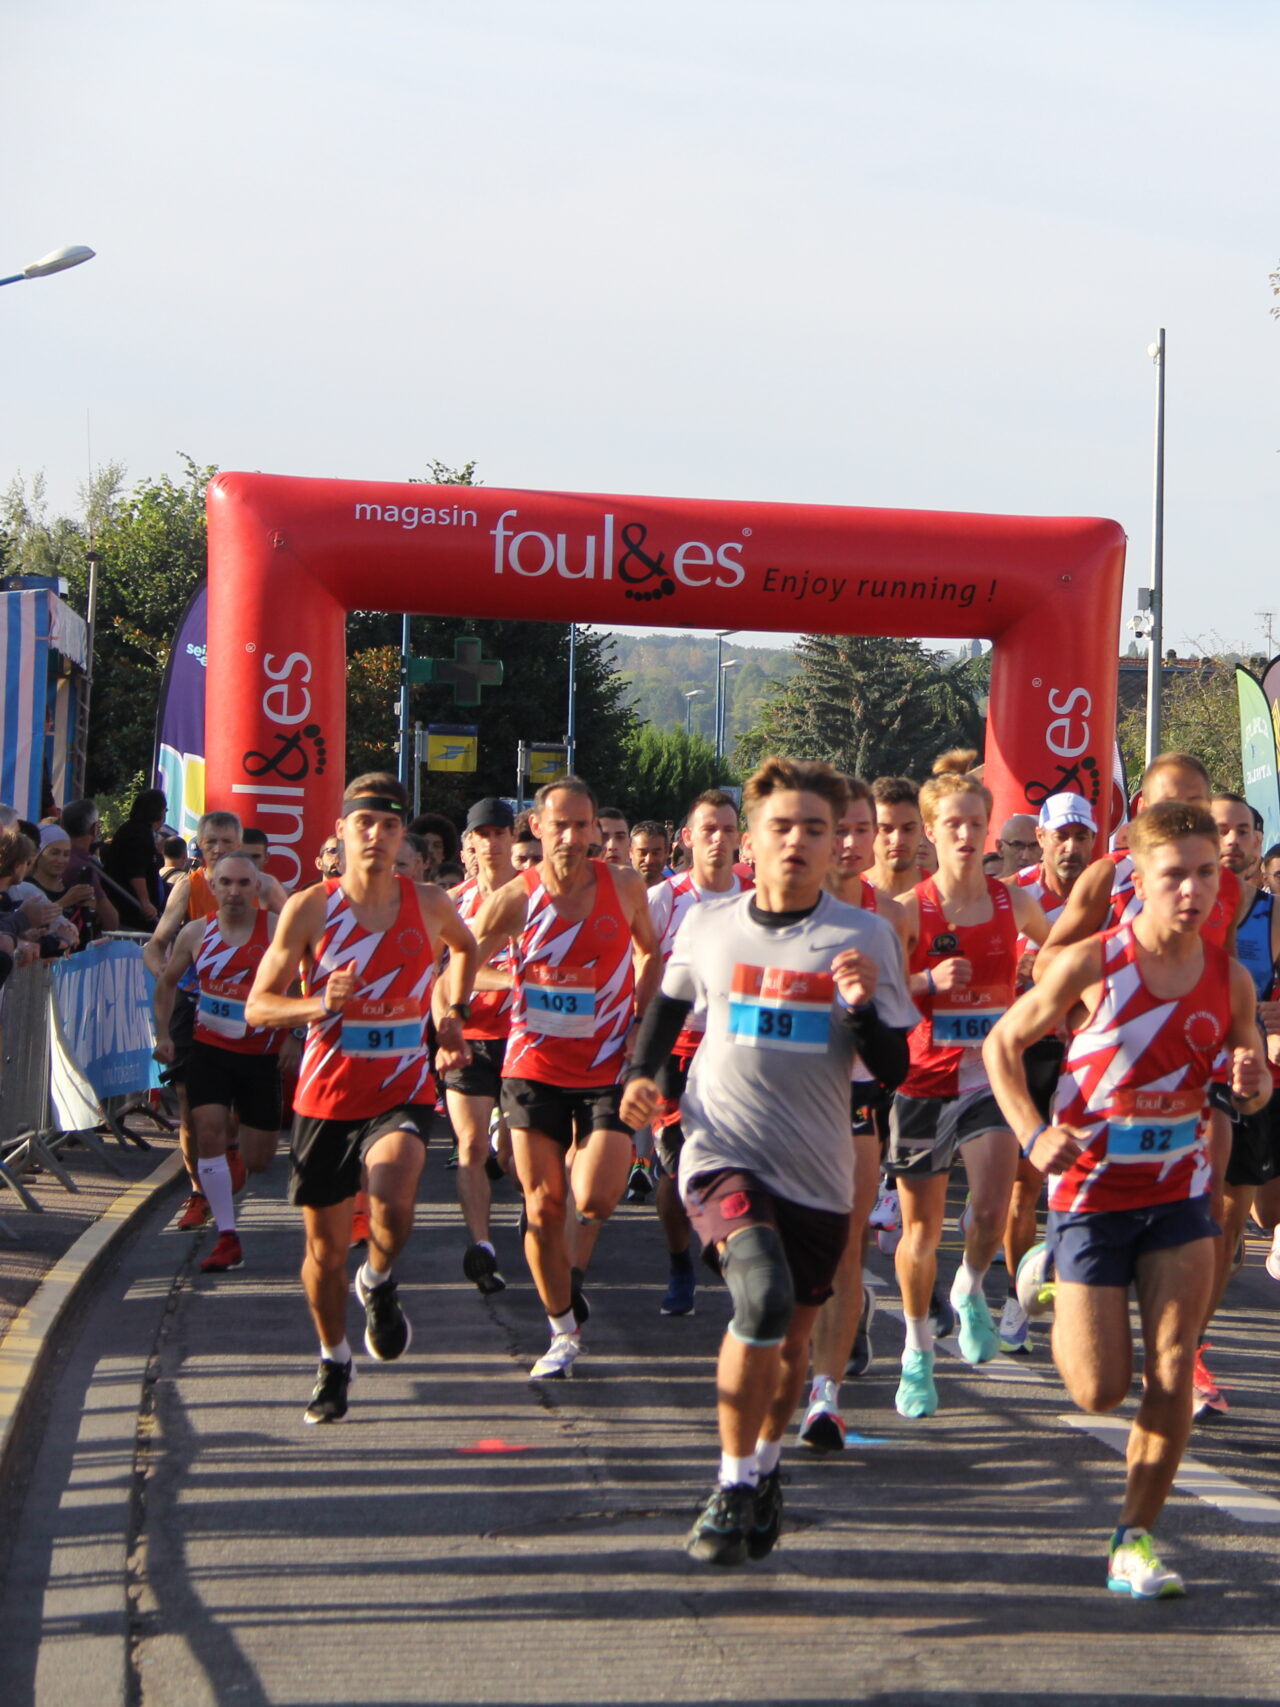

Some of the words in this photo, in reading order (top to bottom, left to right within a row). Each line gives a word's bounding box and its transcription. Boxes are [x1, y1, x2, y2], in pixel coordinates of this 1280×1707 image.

[355, 502, 477, 529] magasin
[762, 568, 847, 602] Enjoy
[856, 576, 976, 608] running
[212, 1002, 230, 1017] 35
[541, 994, 578, 1013] 103
[759, 1010, 793, 1038] 39
[367, 1030, 395, 1049] 91
[1139, 1129, 1173, 1151] 82
